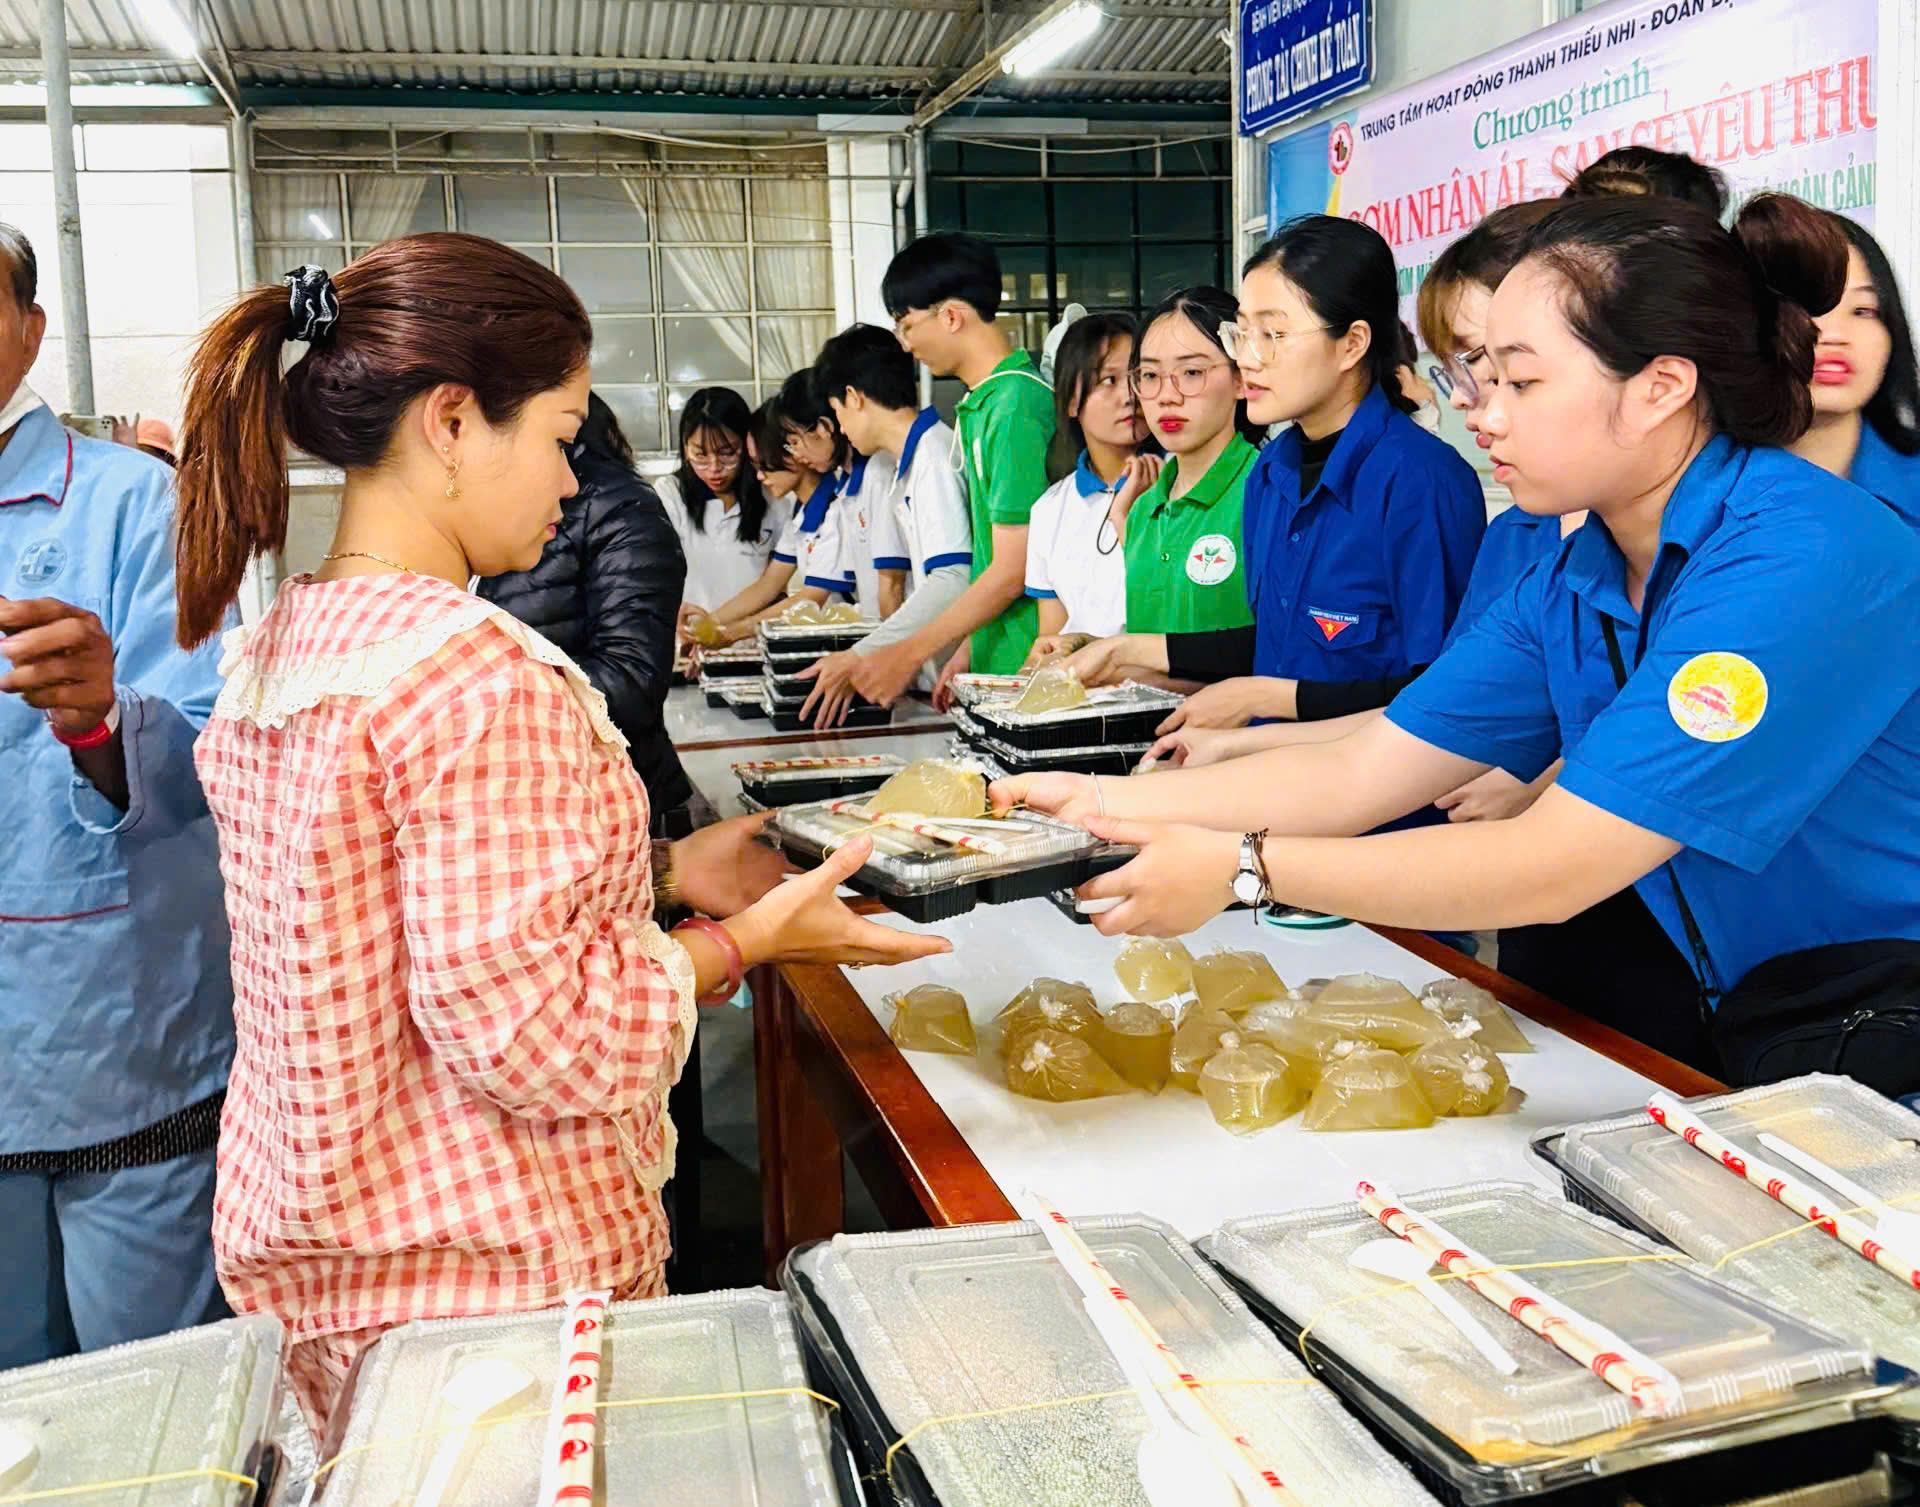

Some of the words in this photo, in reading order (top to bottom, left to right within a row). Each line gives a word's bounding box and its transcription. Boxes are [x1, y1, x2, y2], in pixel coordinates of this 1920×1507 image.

[1246, 49, 1274, 115] PHÒNG
[1334, 0, 1360, 74] TOÁN
[1360, 113, 1396, 141] TRUNG
[1426, 87, 1460, 115] HOẠT
[1463, 71, 1504, 103] ĐỘNG
[1508, 53, 1556, 85] THANH
[1560, 26, 1602, 65] THIẾU
[1606, 19, 1636, 48] NHI
[1473, 87, 1575, 150] Chương
[1578, 57, 1652, 117] trình
[1406, 167, 1488, 242] NHÂN
[1683, 81, 1776, 163] YÊU
